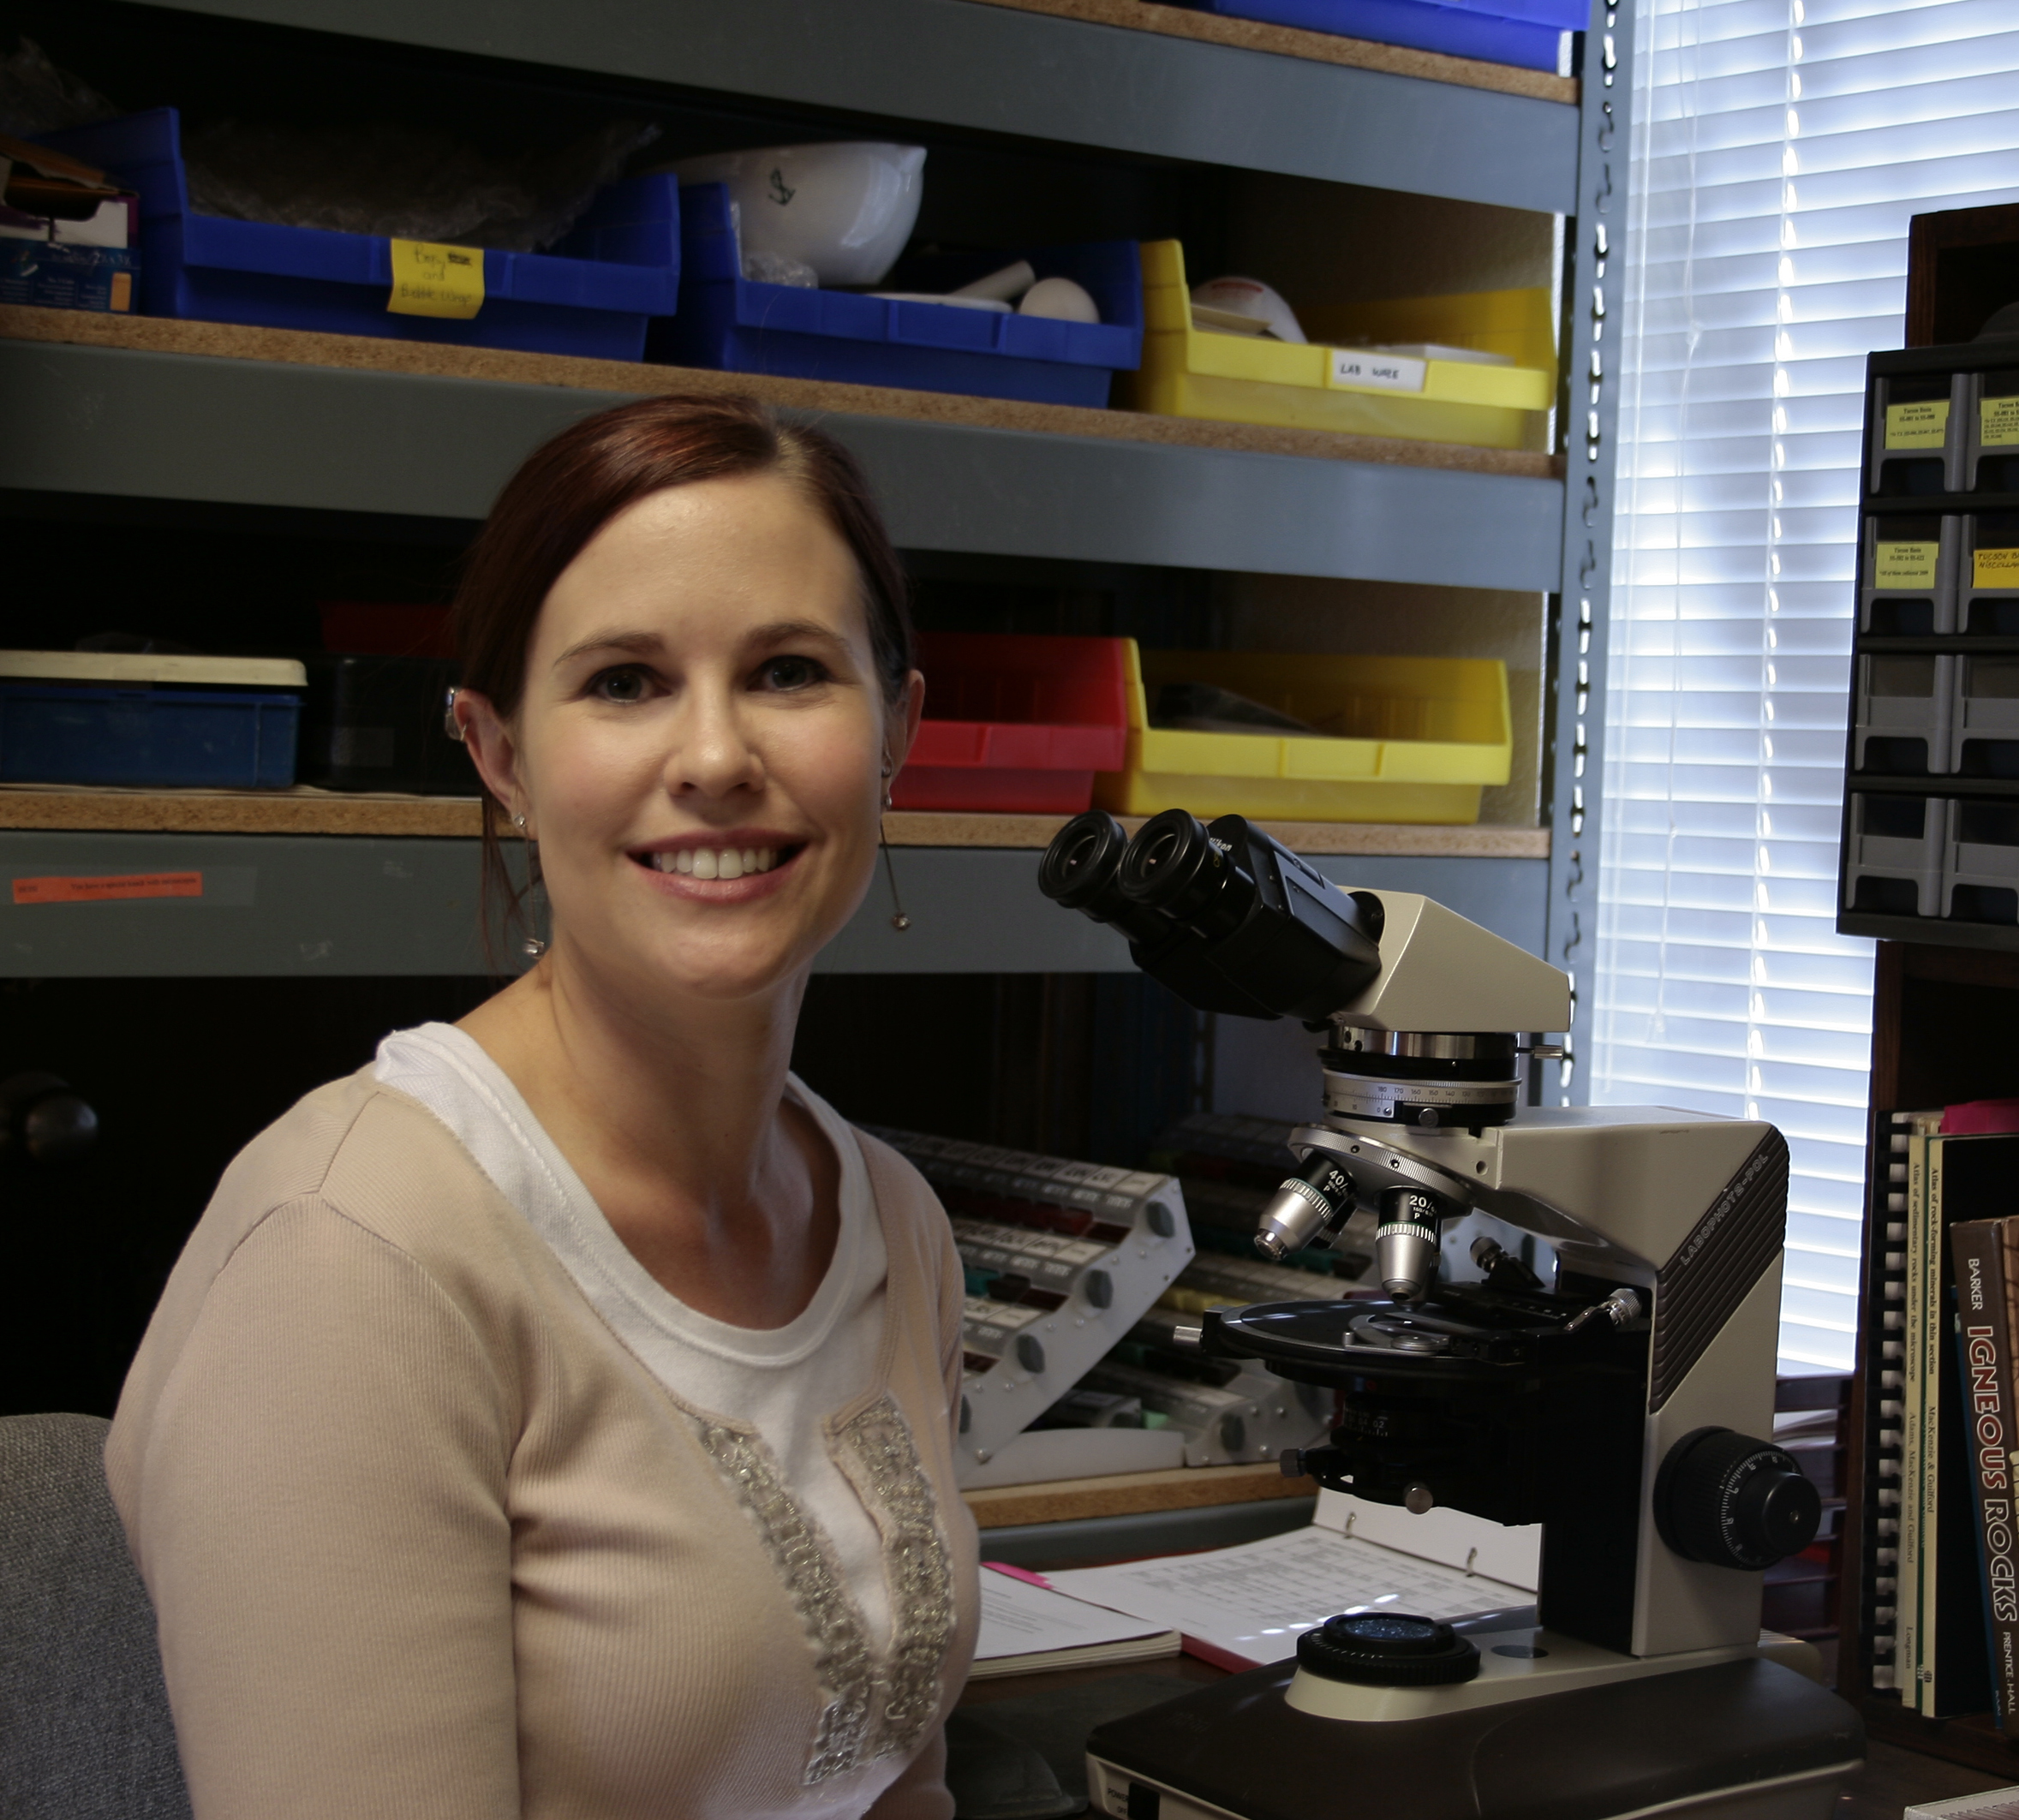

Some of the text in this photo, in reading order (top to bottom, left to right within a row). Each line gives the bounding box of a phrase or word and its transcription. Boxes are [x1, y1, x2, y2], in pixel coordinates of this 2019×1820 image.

[1340, 363, 1361, 375] LAB
[1913, 1188, 1920, 1198] of
[1931, 1194, 1938, 1203] of
[1911, 1201, 1920, 1254] sedimentary
[1929, 1206, 1938, 1265] rock-forming
[1968, 1258, 1984, 1310] BARKER
[1929, 1310, 1937, 1319] in
[1927, 1405, 1936, 1459] MacKenzie
[1926, 1473, 1935, 1513] Guilford
[1967, 1326, 2017, 1622] IGNEOUS ROCKS
[1905, 1626, 1914, 1669] Longman
[1107, 1787, 1129, 1801] POWER
